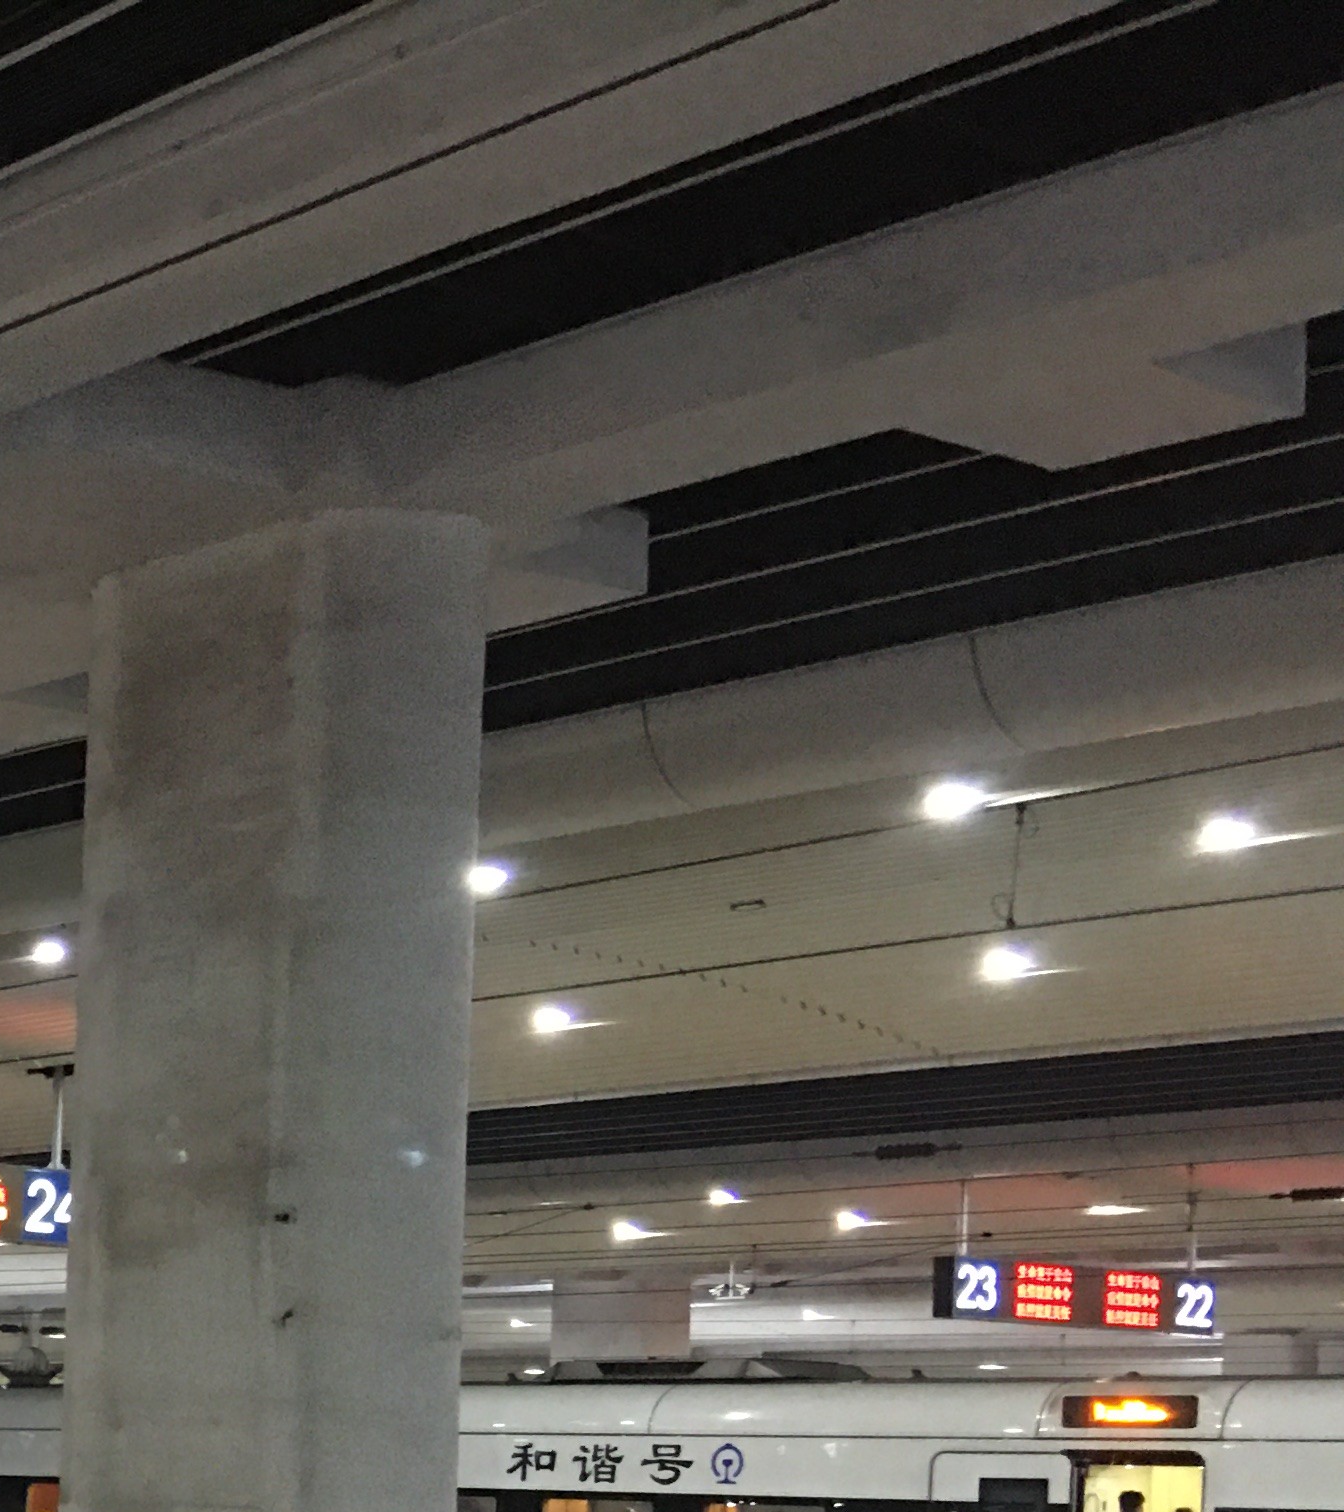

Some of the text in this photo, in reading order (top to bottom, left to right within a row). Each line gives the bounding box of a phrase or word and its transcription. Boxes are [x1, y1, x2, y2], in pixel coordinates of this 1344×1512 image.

[956, 1264, 997, 1310] 23
[1175, 1283, 1213, 1327] 22
[506, 1442, 694, 1486] 和谐号
